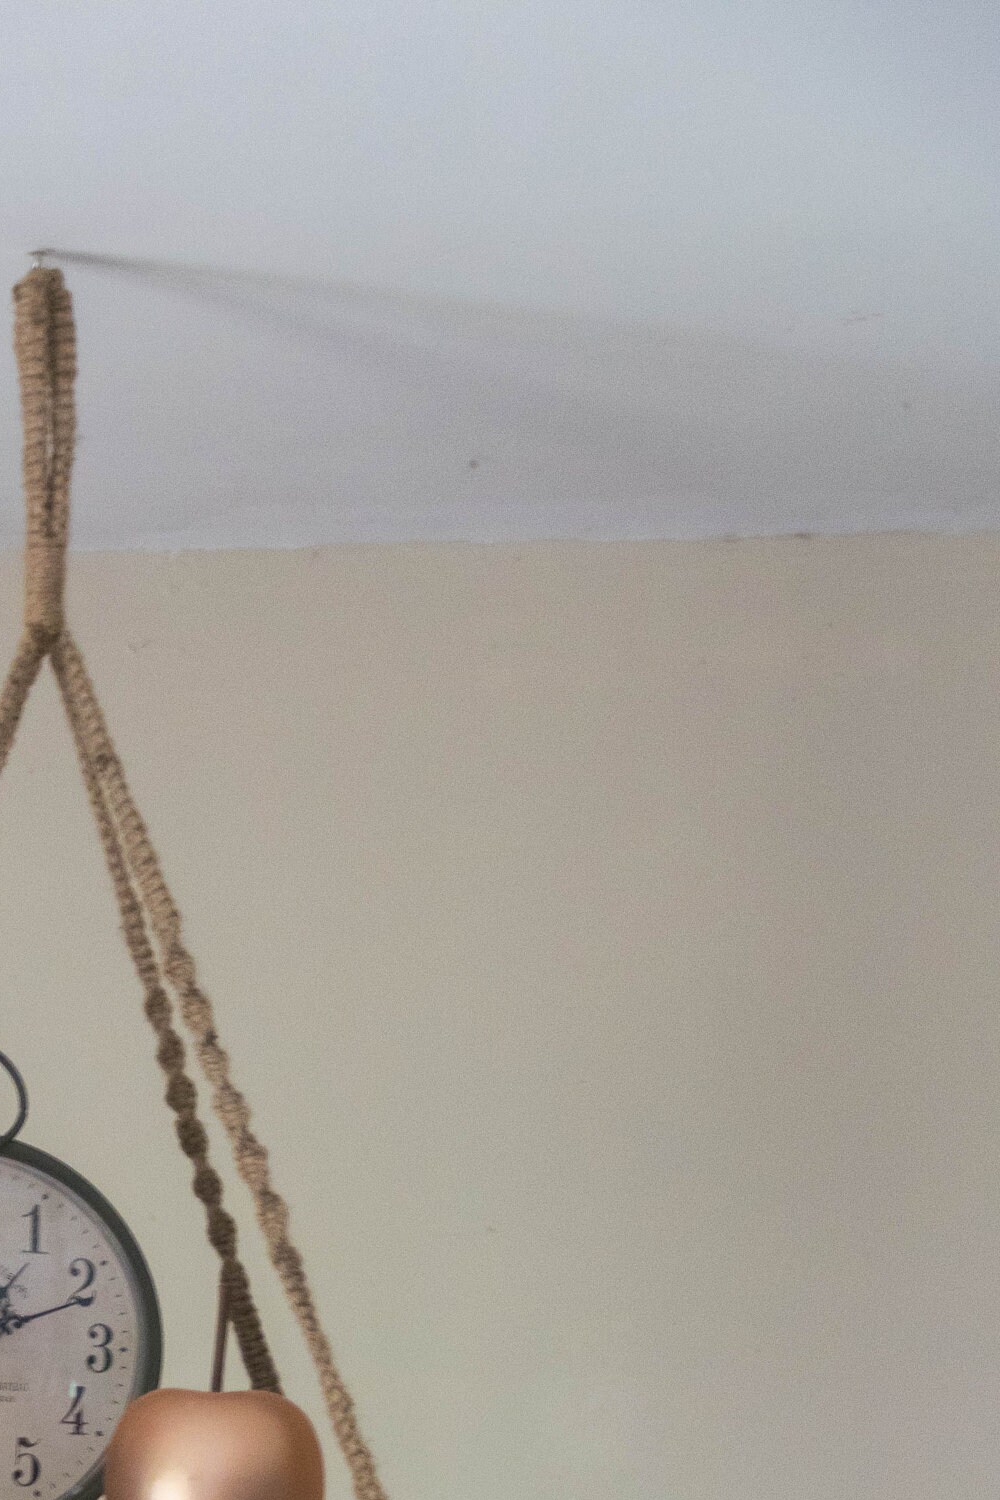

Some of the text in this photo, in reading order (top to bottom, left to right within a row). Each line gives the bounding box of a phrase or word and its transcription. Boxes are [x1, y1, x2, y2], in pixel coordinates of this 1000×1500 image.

[21, 1204, 49, 1255] 1
[67, 1257, 97, 1307] 2
[86, 1323, 113, 1373] 3
[60, 1385, 90, 1436] 4
[12, 1437, 42, 1487] 5
